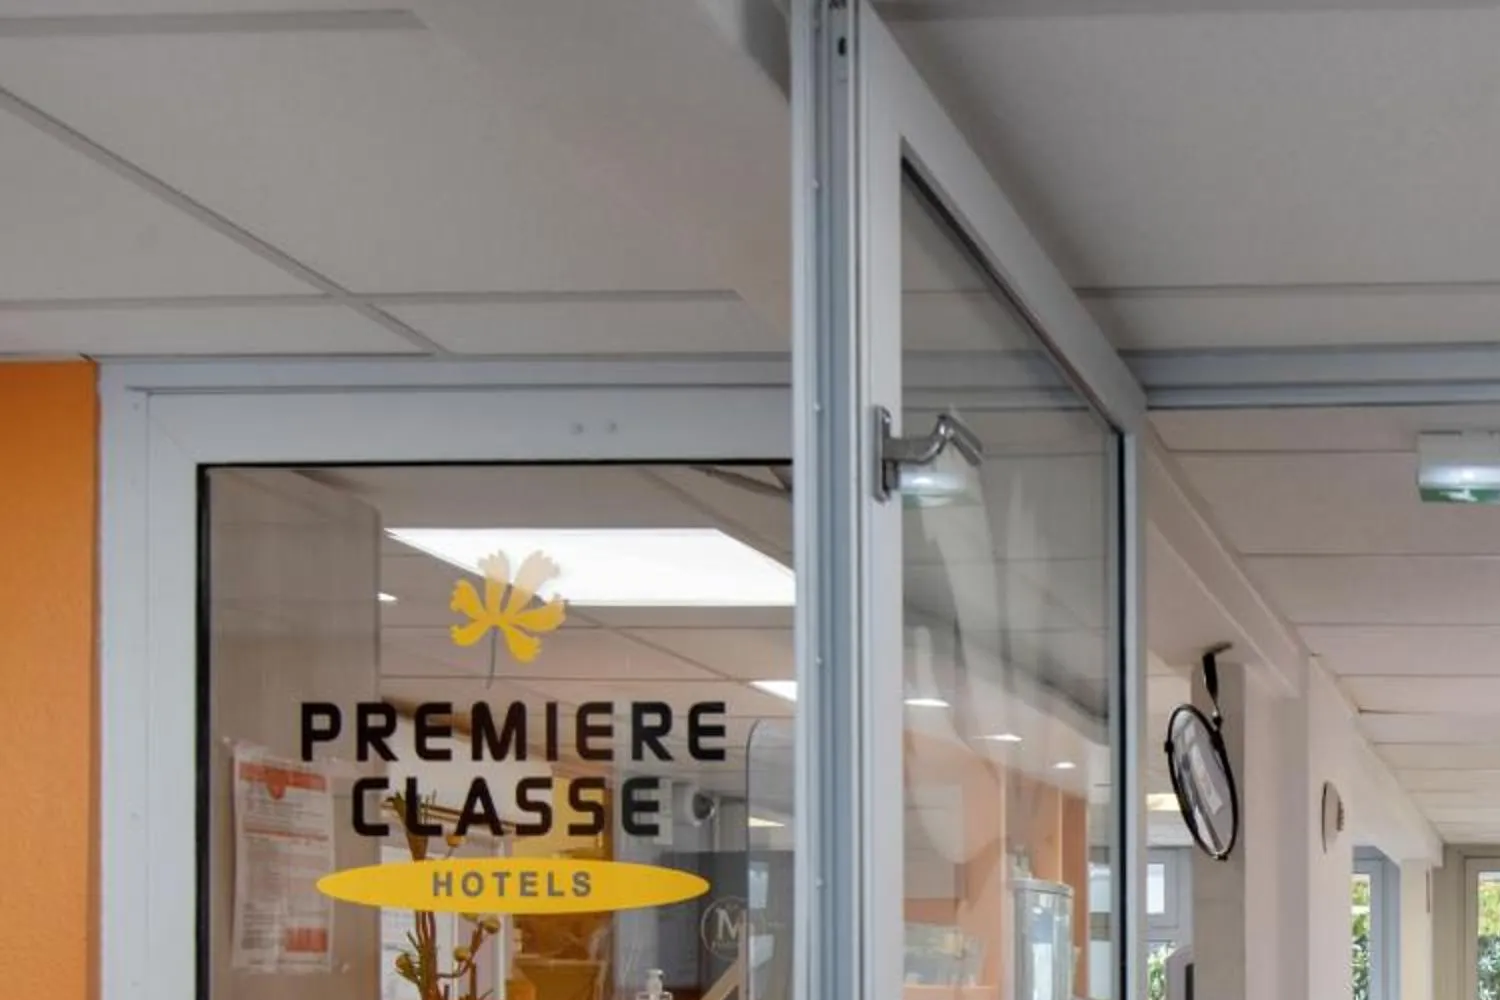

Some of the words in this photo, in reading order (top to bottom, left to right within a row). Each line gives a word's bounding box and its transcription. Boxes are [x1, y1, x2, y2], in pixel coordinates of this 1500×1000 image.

[300, 701, 727, 762] PREMIERE
[352, 777, 660, 837] CLASSE
[432, 871, 593, 897] HOTELS
